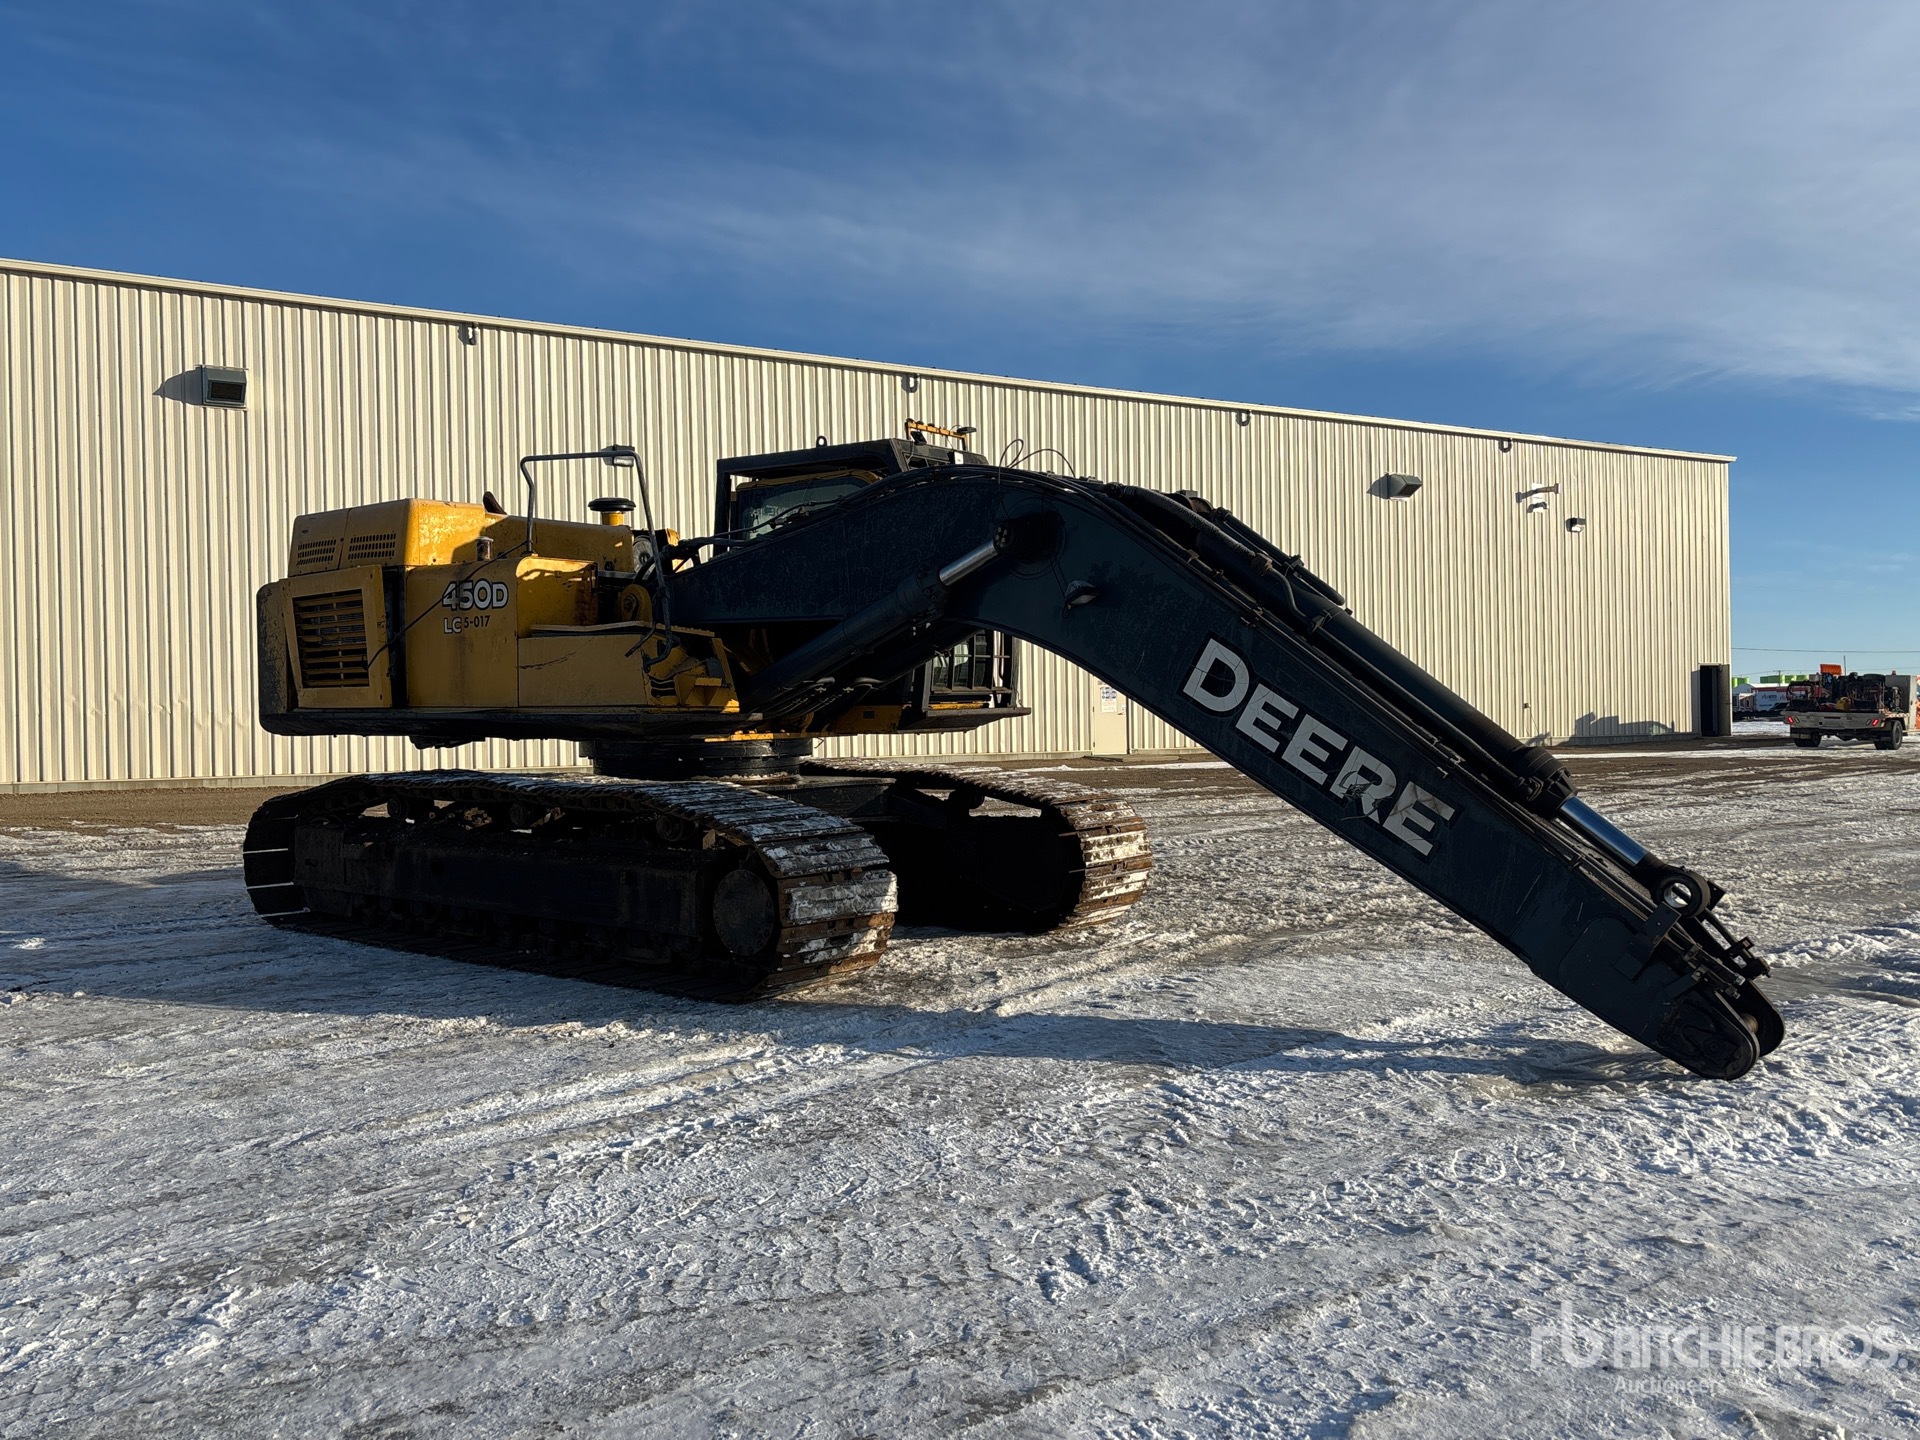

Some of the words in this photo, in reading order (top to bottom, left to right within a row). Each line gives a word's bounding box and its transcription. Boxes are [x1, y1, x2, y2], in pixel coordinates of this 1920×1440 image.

[442, 579, 509, 611] 450D
[444, 617, 462, 634] LC
[463, 615, 490, 629] 5-017
[1182, 637, 1456, 857] DEERE
